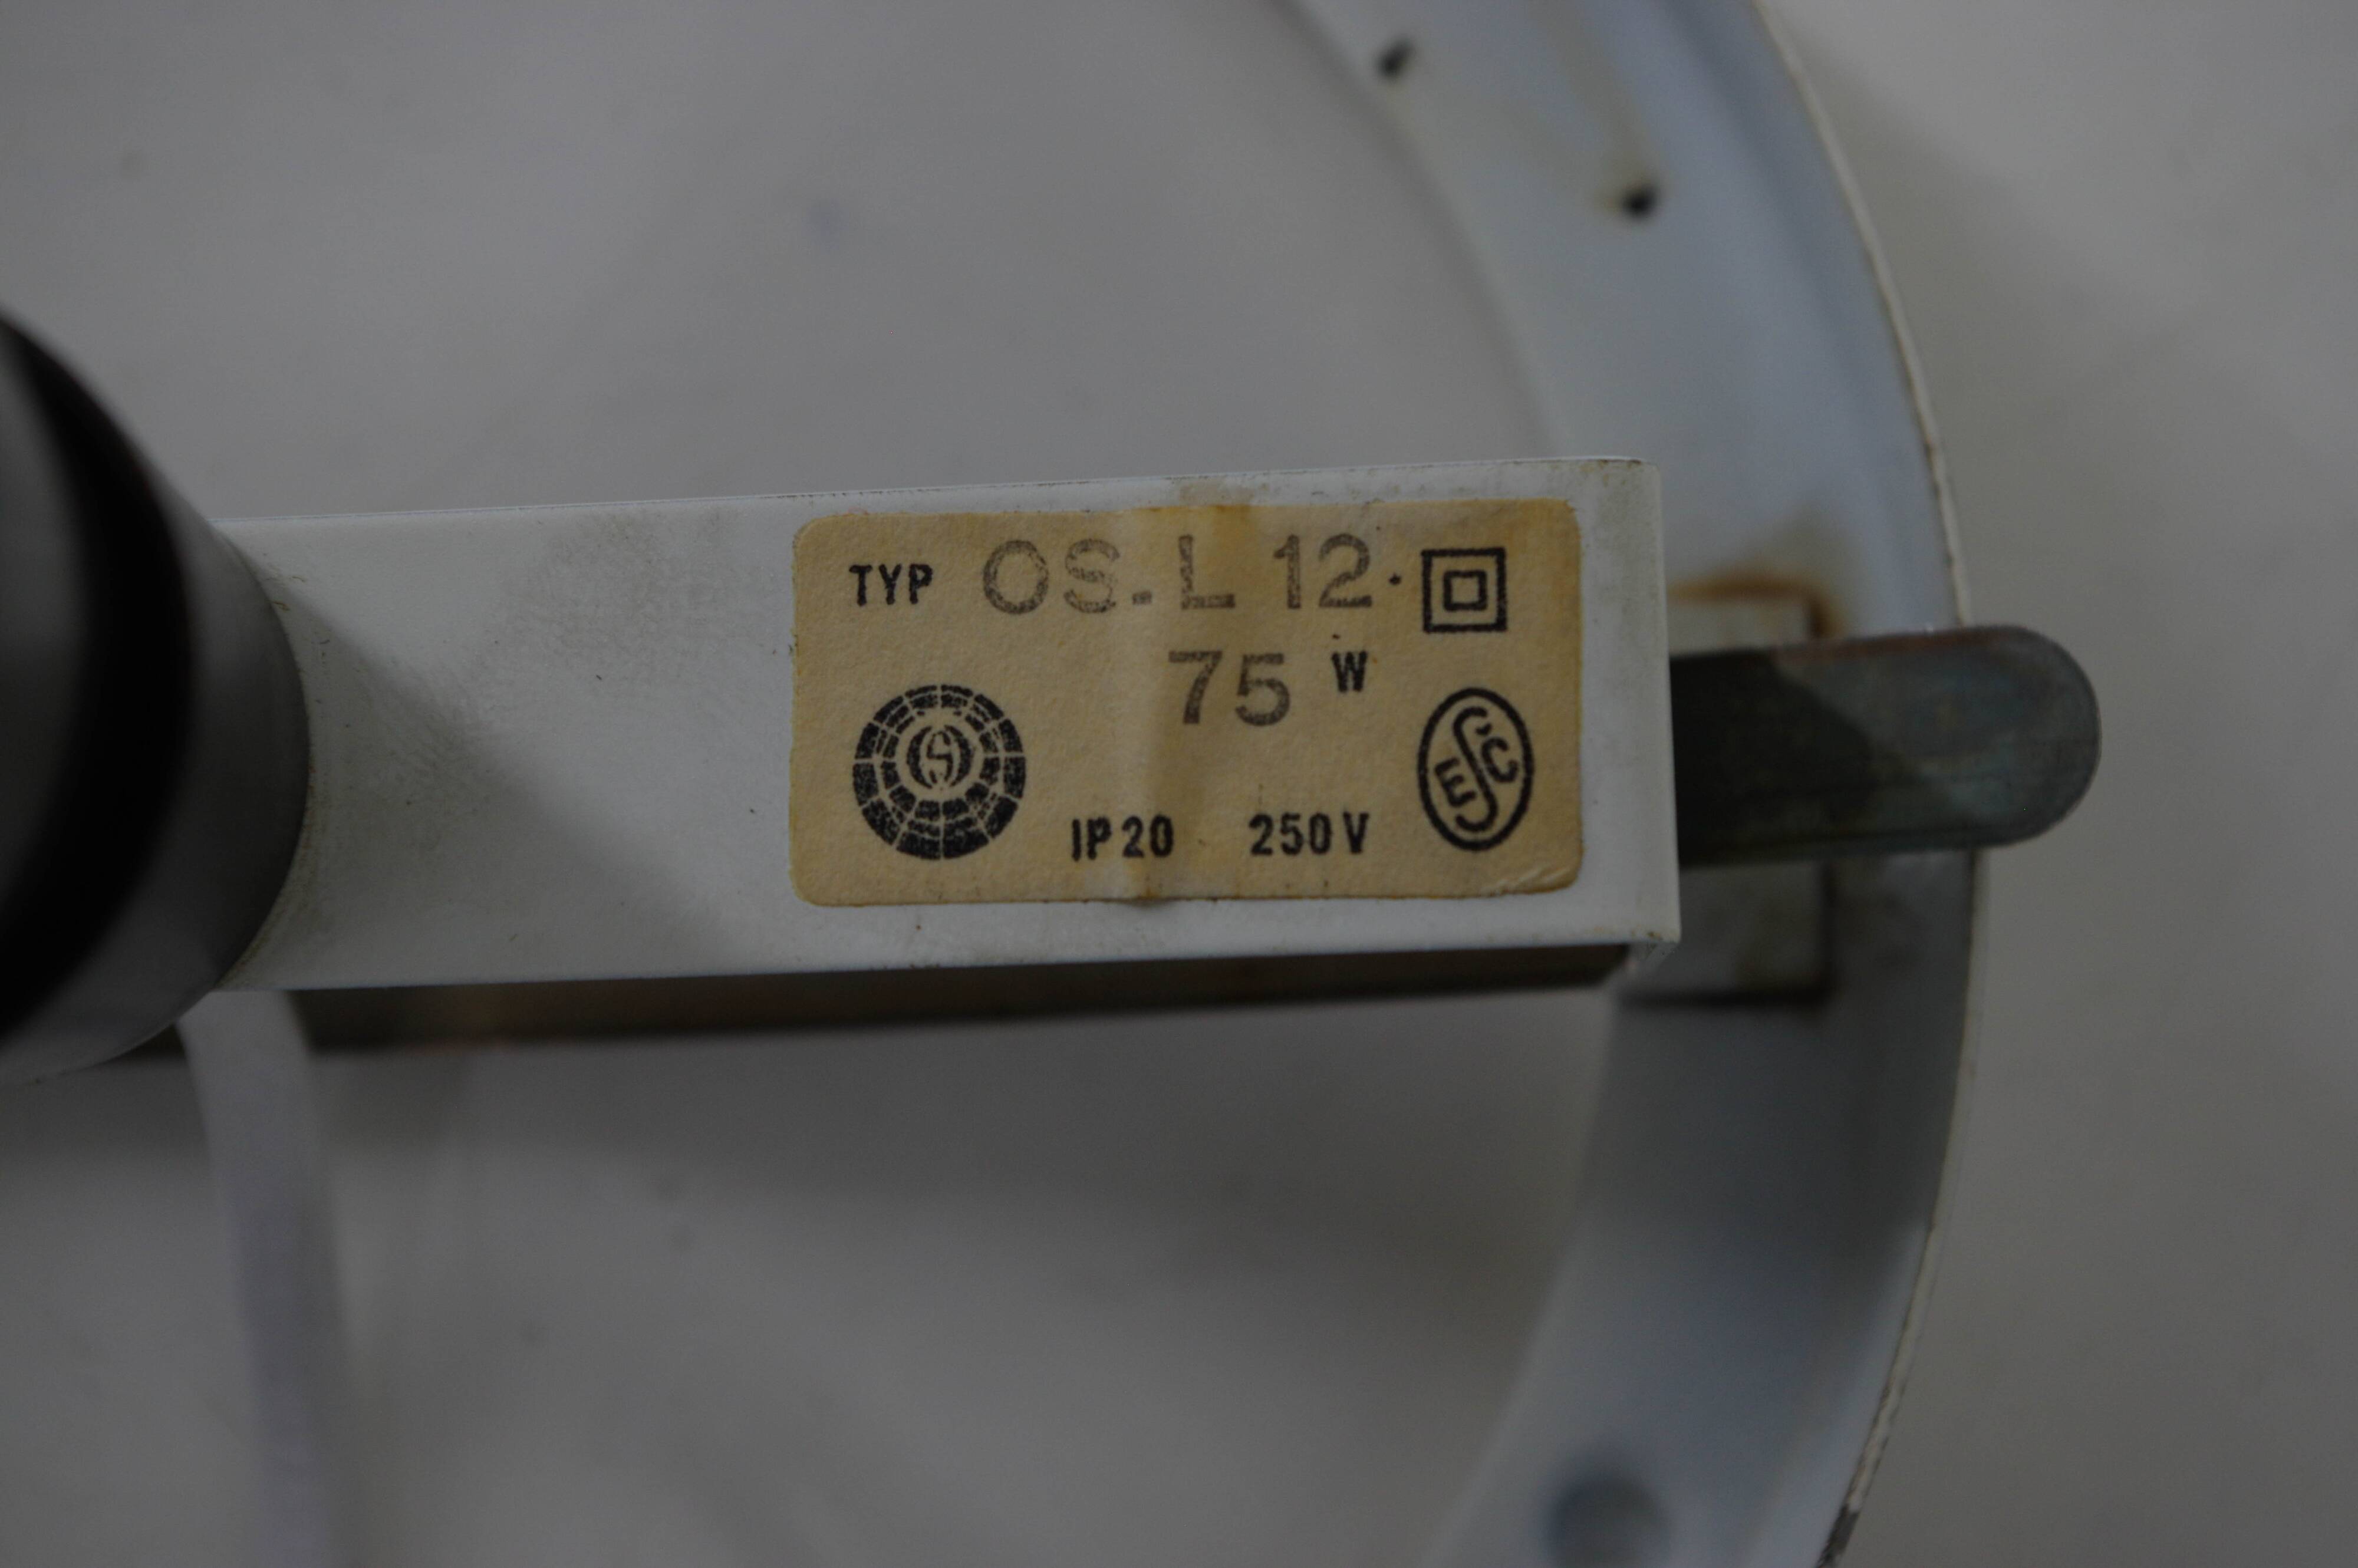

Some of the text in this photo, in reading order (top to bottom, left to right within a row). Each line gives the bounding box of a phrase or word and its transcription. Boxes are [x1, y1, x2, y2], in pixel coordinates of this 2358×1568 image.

[849, 564, 933, 606] TYP
[1168, 650, 1368, 726] 75 W
